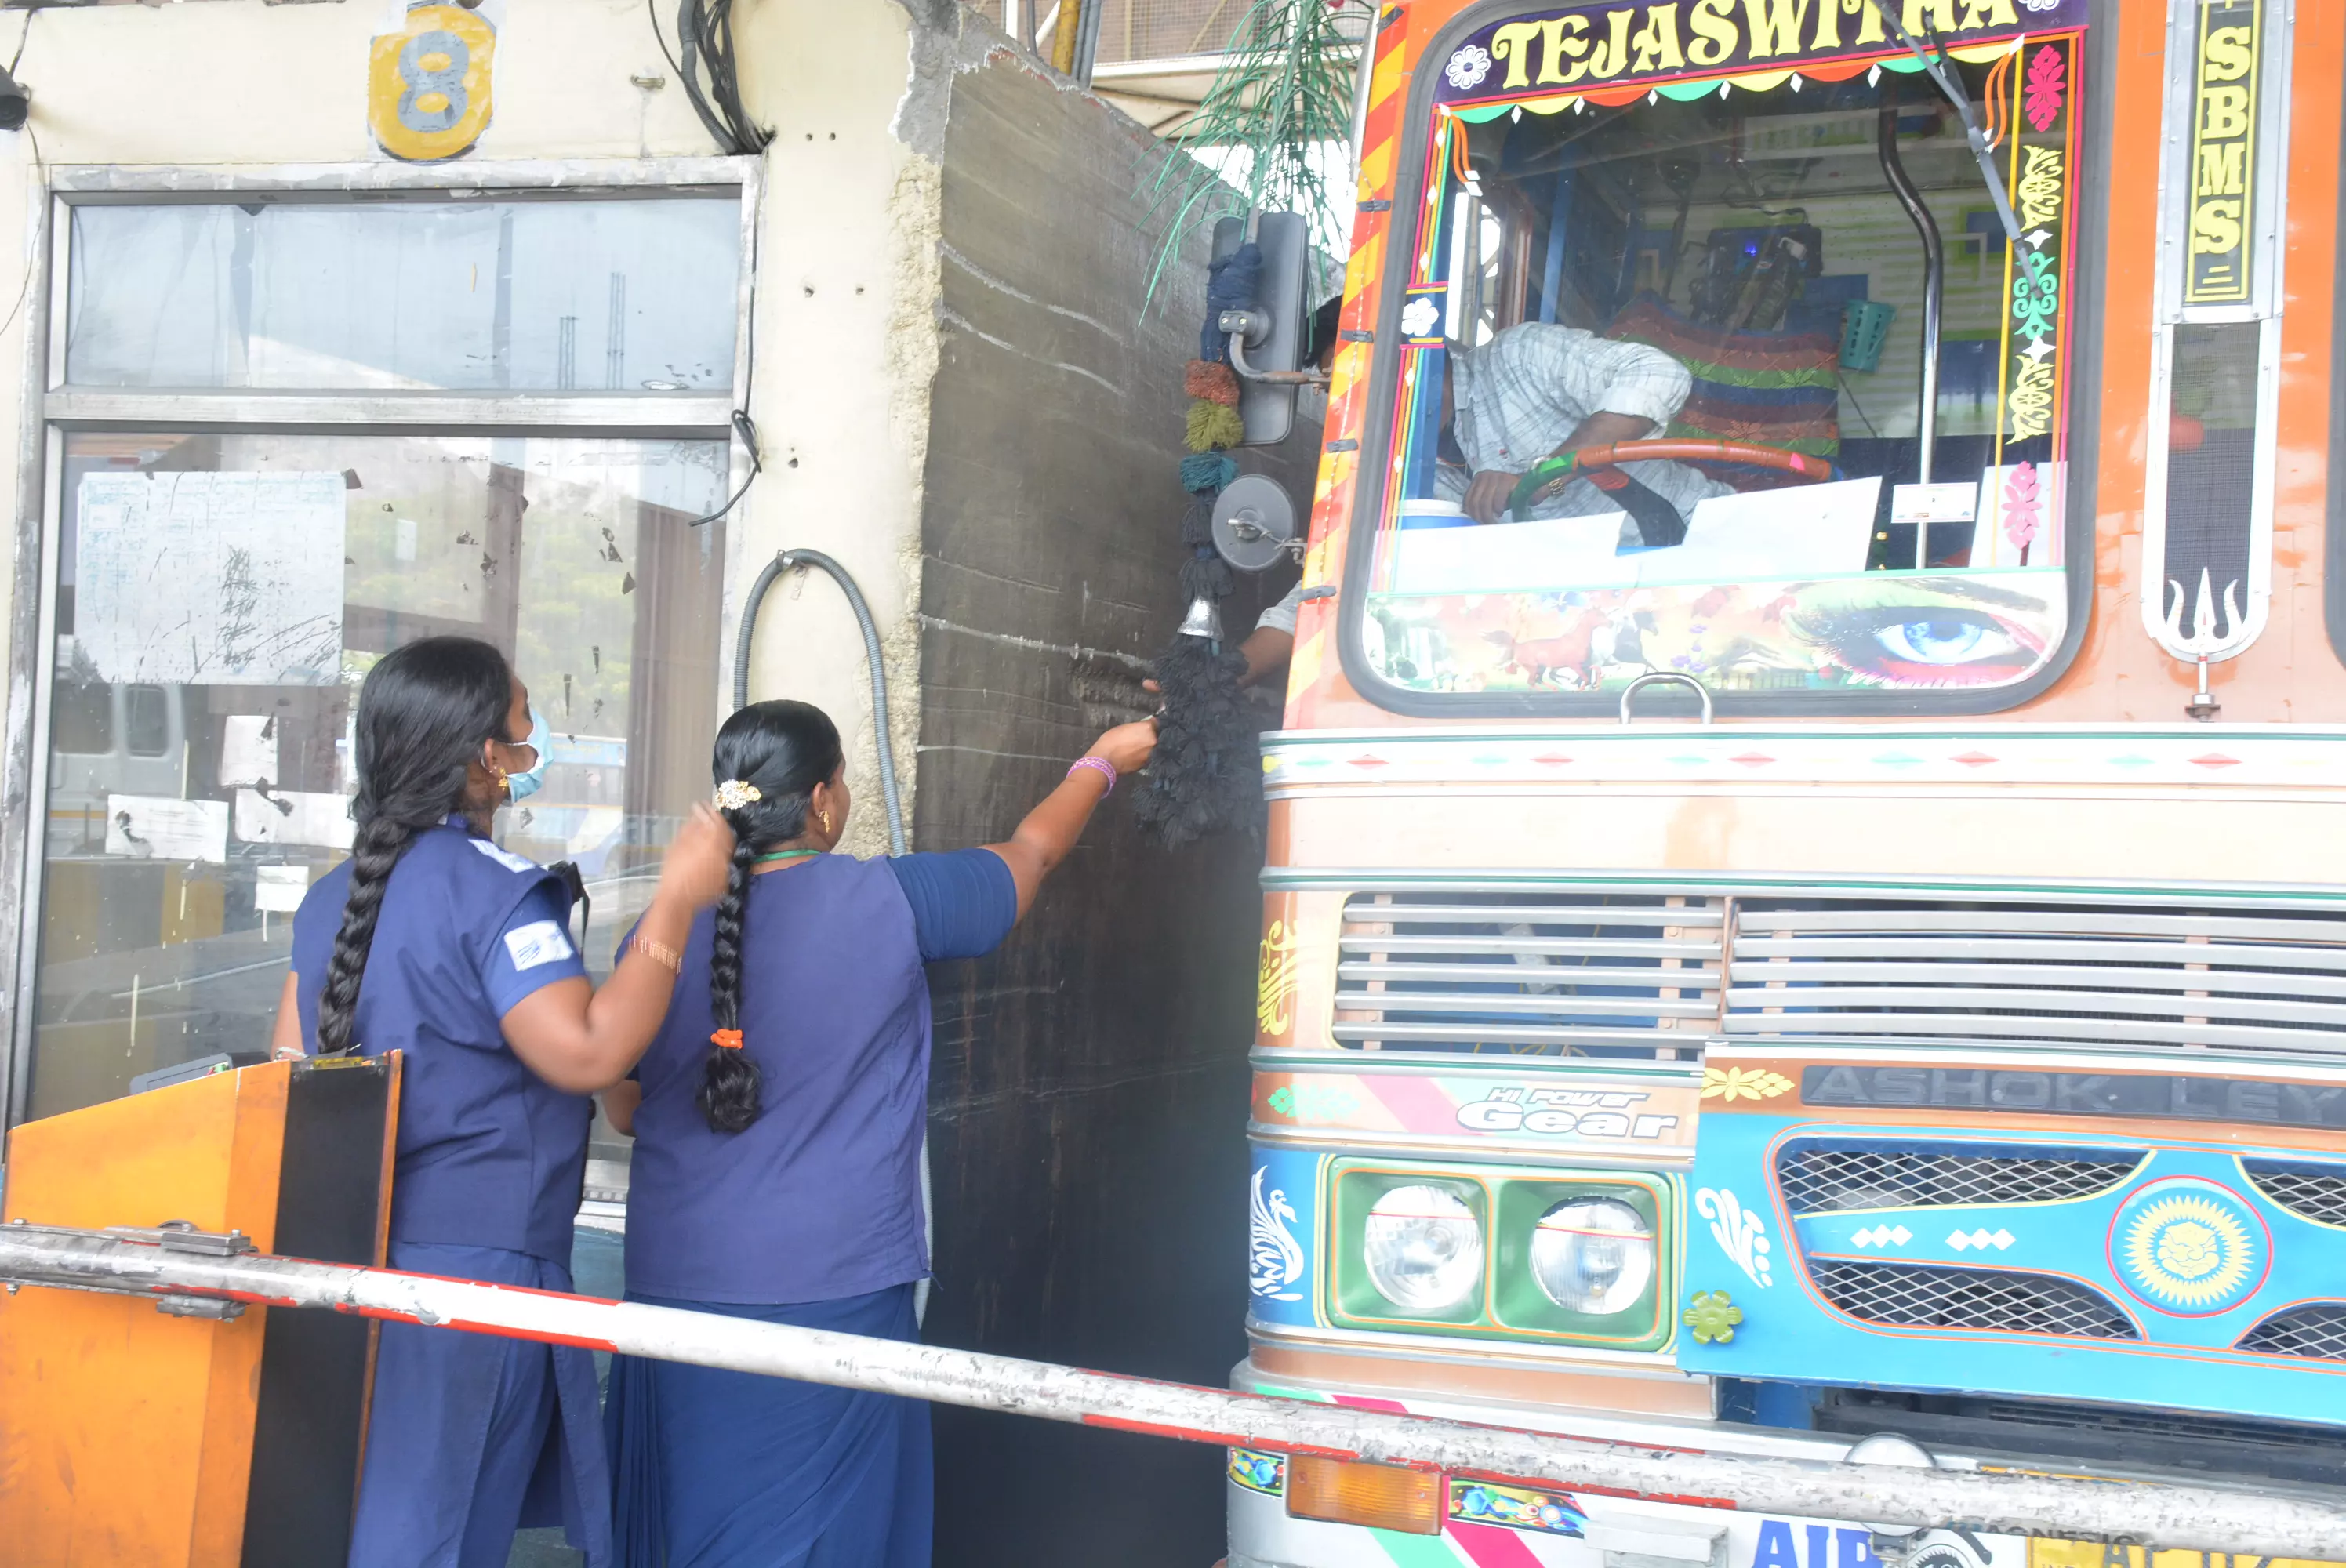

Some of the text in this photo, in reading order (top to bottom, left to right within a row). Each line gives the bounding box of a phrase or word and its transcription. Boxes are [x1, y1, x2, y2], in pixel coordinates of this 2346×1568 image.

[397, 31, 470, 132] 8
[1808, 1065, 2113, 1111] ASHOK
[1455, 1099, 1679, 1139] Gear
